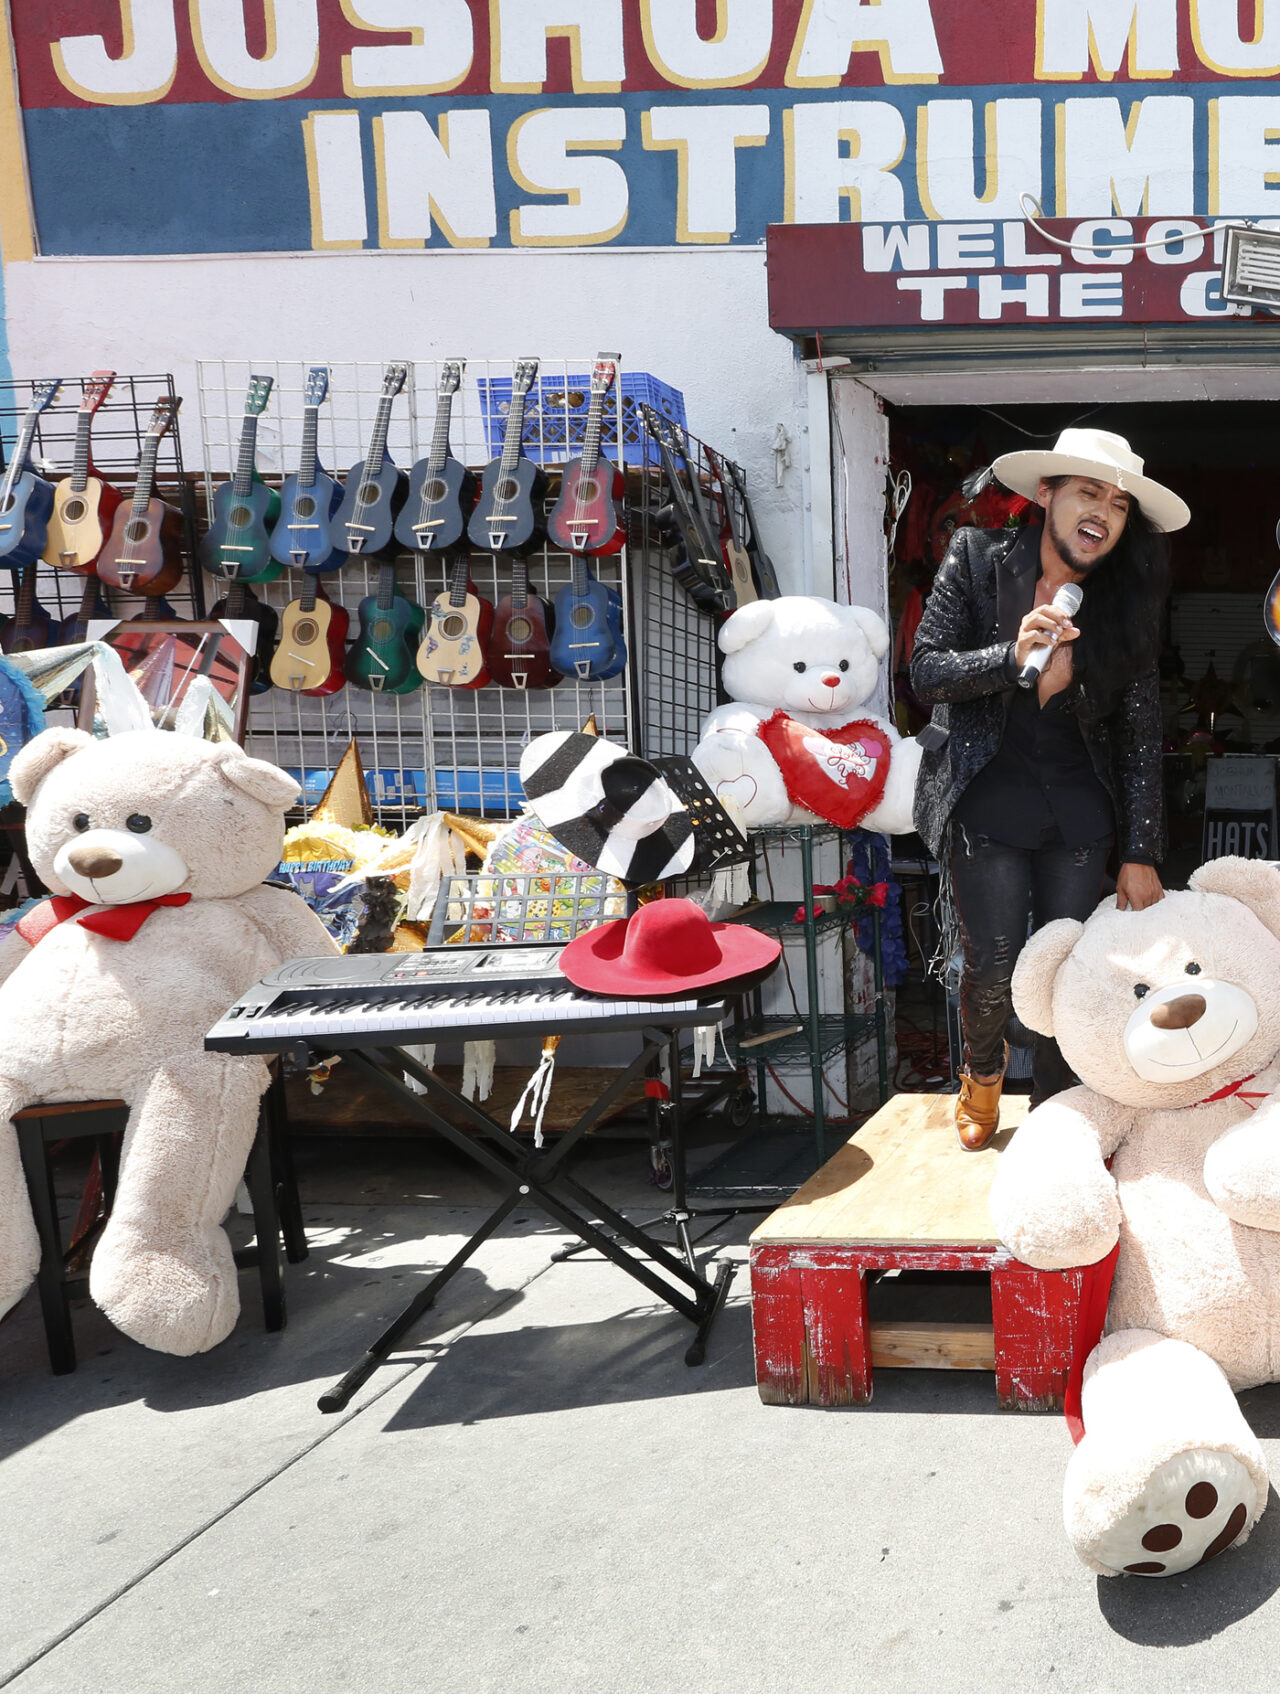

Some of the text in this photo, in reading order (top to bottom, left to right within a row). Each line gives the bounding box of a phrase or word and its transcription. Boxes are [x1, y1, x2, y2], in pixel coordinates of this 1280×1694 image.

[50, 0, 943, 106] JOSHUA
[897, 272, 1123, 320] THE
[1207, 821, 1269, 860] HATS
